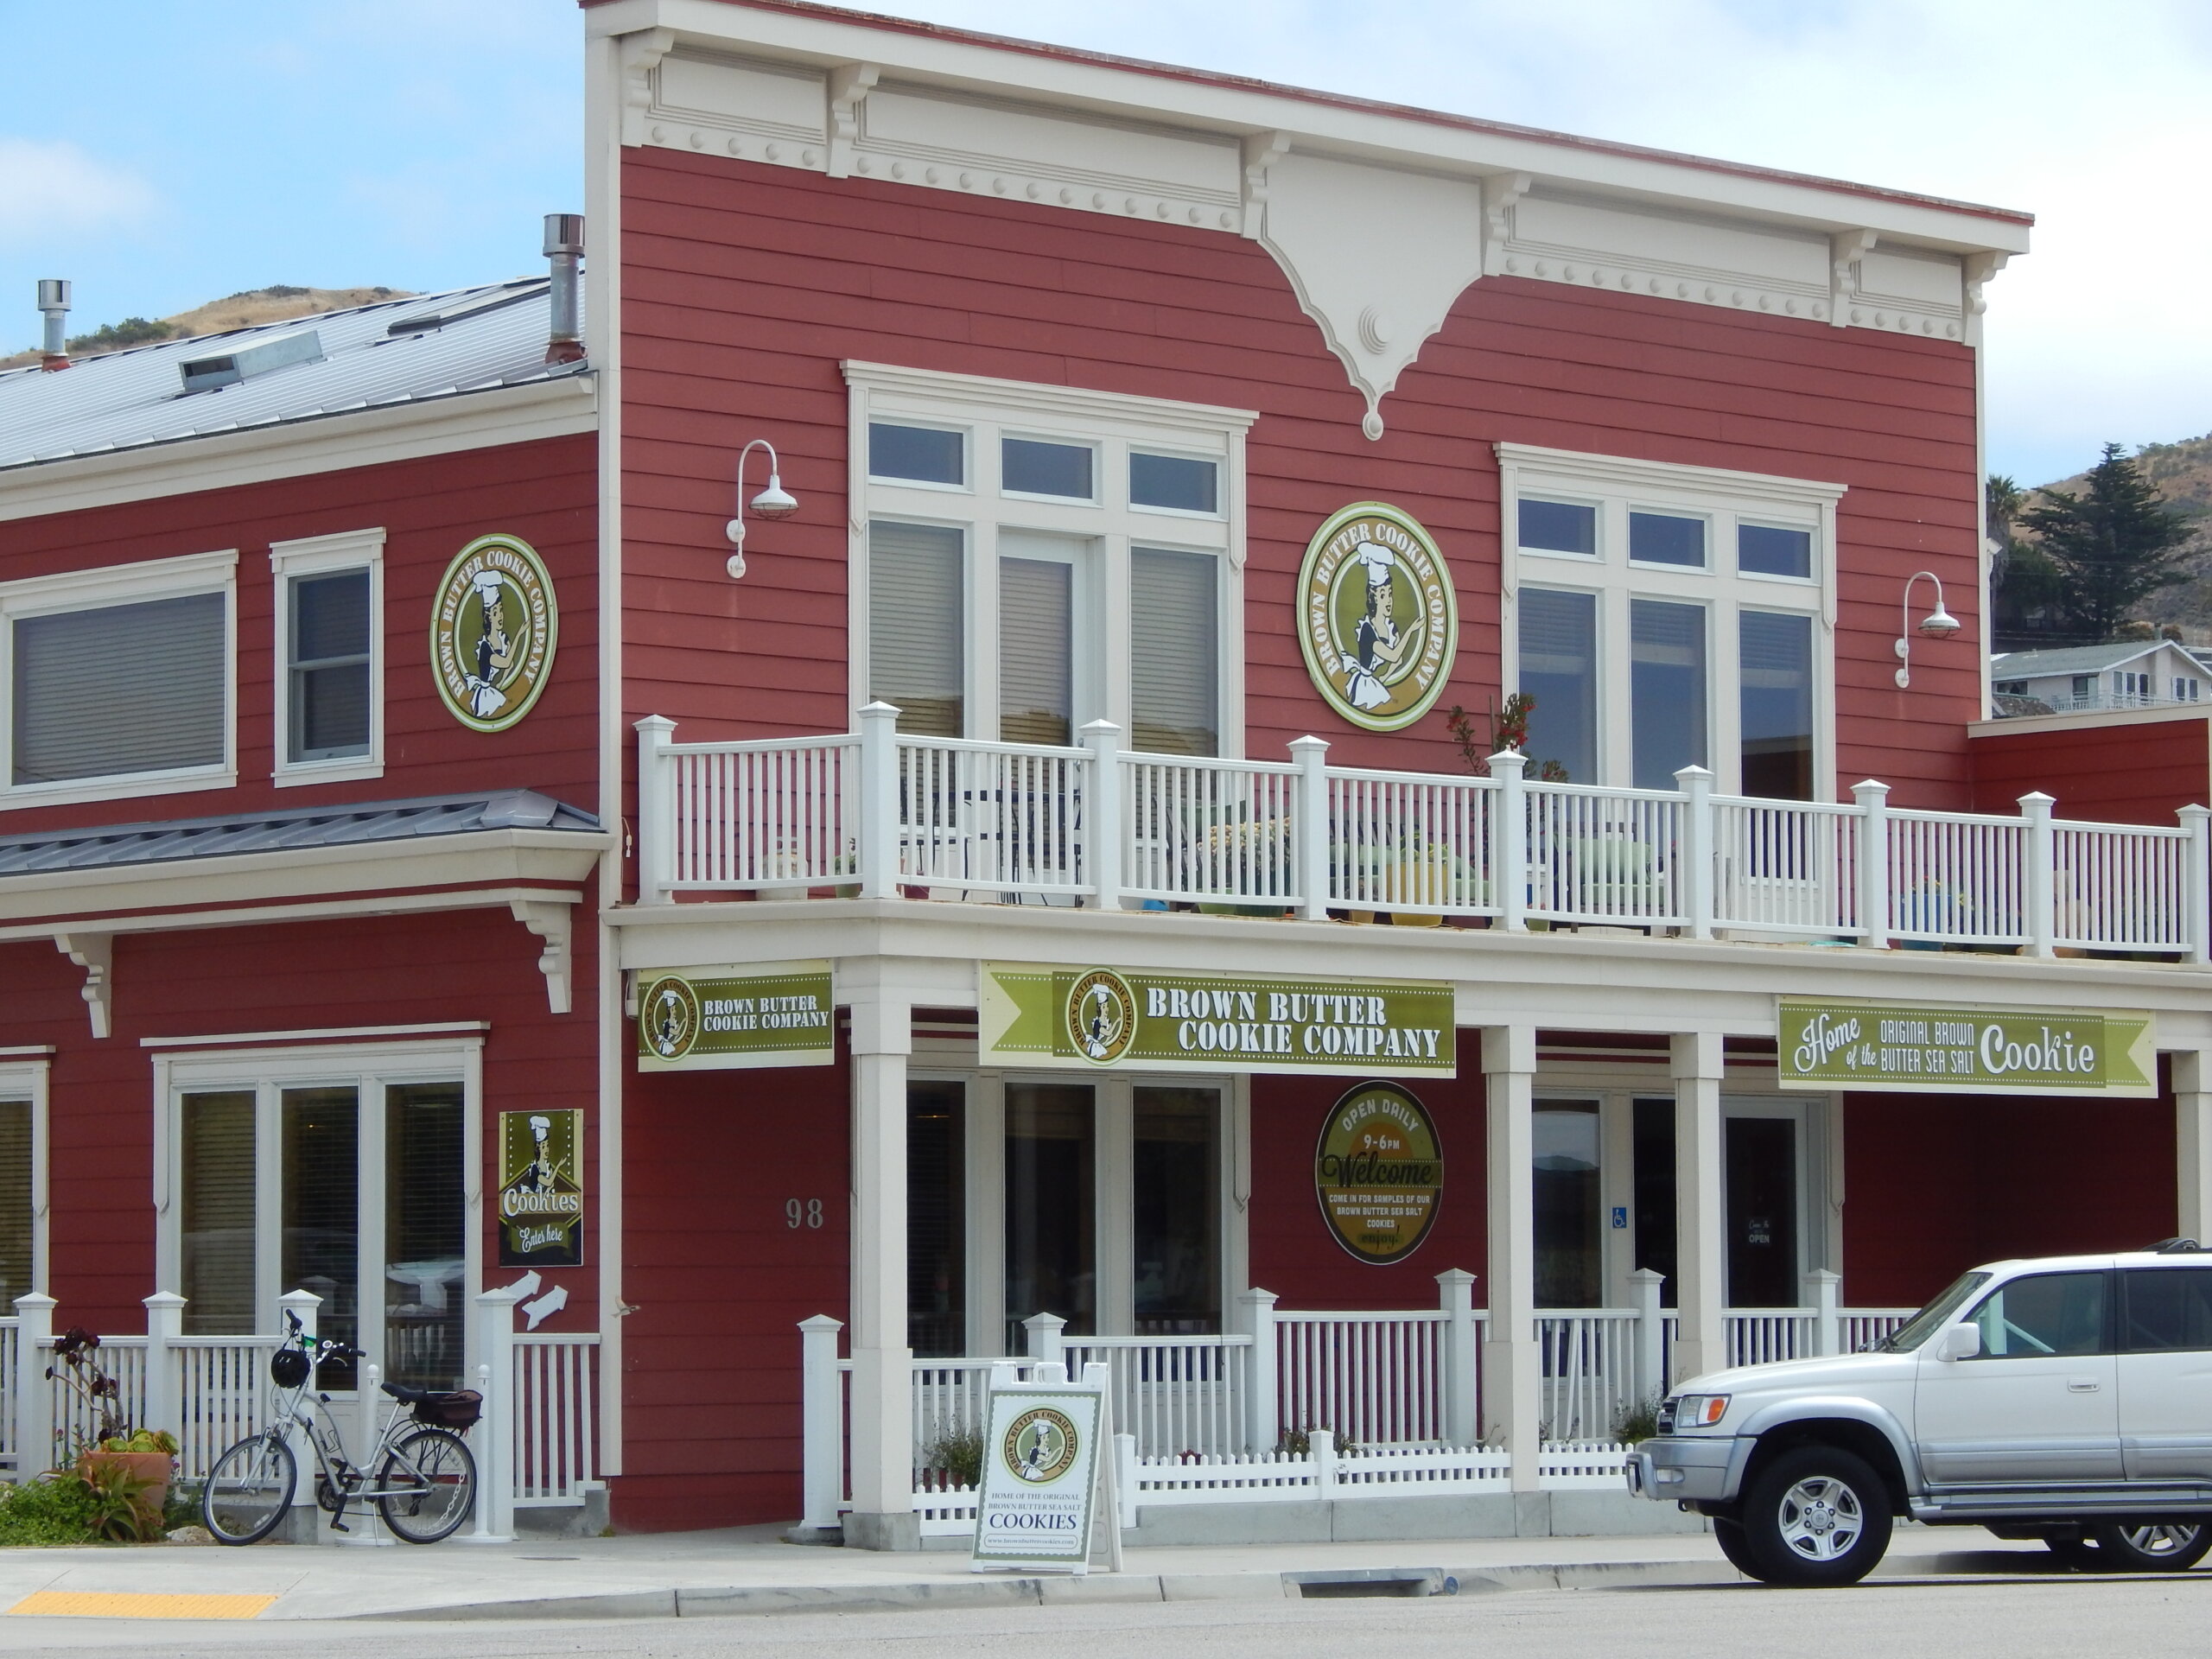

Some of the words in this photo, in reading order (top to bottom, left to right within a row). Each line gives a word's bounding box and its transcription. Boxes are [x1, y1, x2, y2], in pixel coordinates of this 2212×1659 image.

[1316, 523, 1371, 586] BUTTER
[1375, 523, 1433, 582] COOKIE
[486, 550, 535, 588] COOKIE
[442, 556, 484, 623] BUTTER
[524, 587, 546, 684] COMPANY
[1312, 591, 1340, 677] BROWN
[1414, 584, 1445, 690] COMPANY
[441, 631, 466, 699] BROWN
[704, 998, 754, 1015] BROWN
[760, 995, 817, 1013] BUTTER
[1146, 987, 1258, 1021] BROWN
[1268, 991, 1387, 1027] BUTTER
[703, 1015, 758, 1032] COOKIE
[761, 1011, 829, 1029] COMPANY
[1880, 1020, 1930, 1046] ORIGINAL
[1935, 1021, 1974, 1046] BROWN
[1178, 1020, 1292, 1054] COOKIE
[1303, 1025, 1440, 1058] COMPANY
[1794, 1013, 1860, 1073] Home
[1980, 1024, 2095, 1075] Cookie
[1846, 1045, 1859, 1071] of
[1860, 1043, 1877, 1065] the
[1880, 1048, 1921, 1073] BUTTER
[1925, 1049, 1946, 1073] SEA
[1949, 1050, 1974, 1074] SALT
[1342, 1098, 1376, 1132] OPEN
[1382, 1098, 1419, 1132] DAILY
[1321, 1151, 1434, 1188] Welcome
[503, 1185, 579, 1217] Cookies
[785, 1198, 823, 1229] 98
[1329, 1195, 1348, 1204] COME
[1350, 1195, 1357, 1204] IN
[1358, 1195, 1371, 1204] FOR
[1373, 1195, 1404, 1204] SAMPLES
[1406, 1195, 1415, 1204] OF
[1417, 1195, 1431, 1204] OUR
[1337, 1207, 1361, 1216] BROWN
[1363, 1207, 1389, 1216] BUTTER
[1390, 1207, 1404, 1216] SEA
[1405, 1207, 1422, 1216] SALT
[519, 1227, 545, 1253] Enter
[546, 1224, 563, 1242] here
[1367, 1219, 1395, 1229] COOKIES
[1749, 1234, 1770, 1243] OPEN
[1012, 1413, 1039, 1438] BUTTER
[1041, 1410, 1070, 1430] COOKIE
[1007, 1440, 1020, 1471] BROWN
[1058, 1432, 1076, 1471] COMPANY
[989, 1513, 1077, 1530] COOKIES
